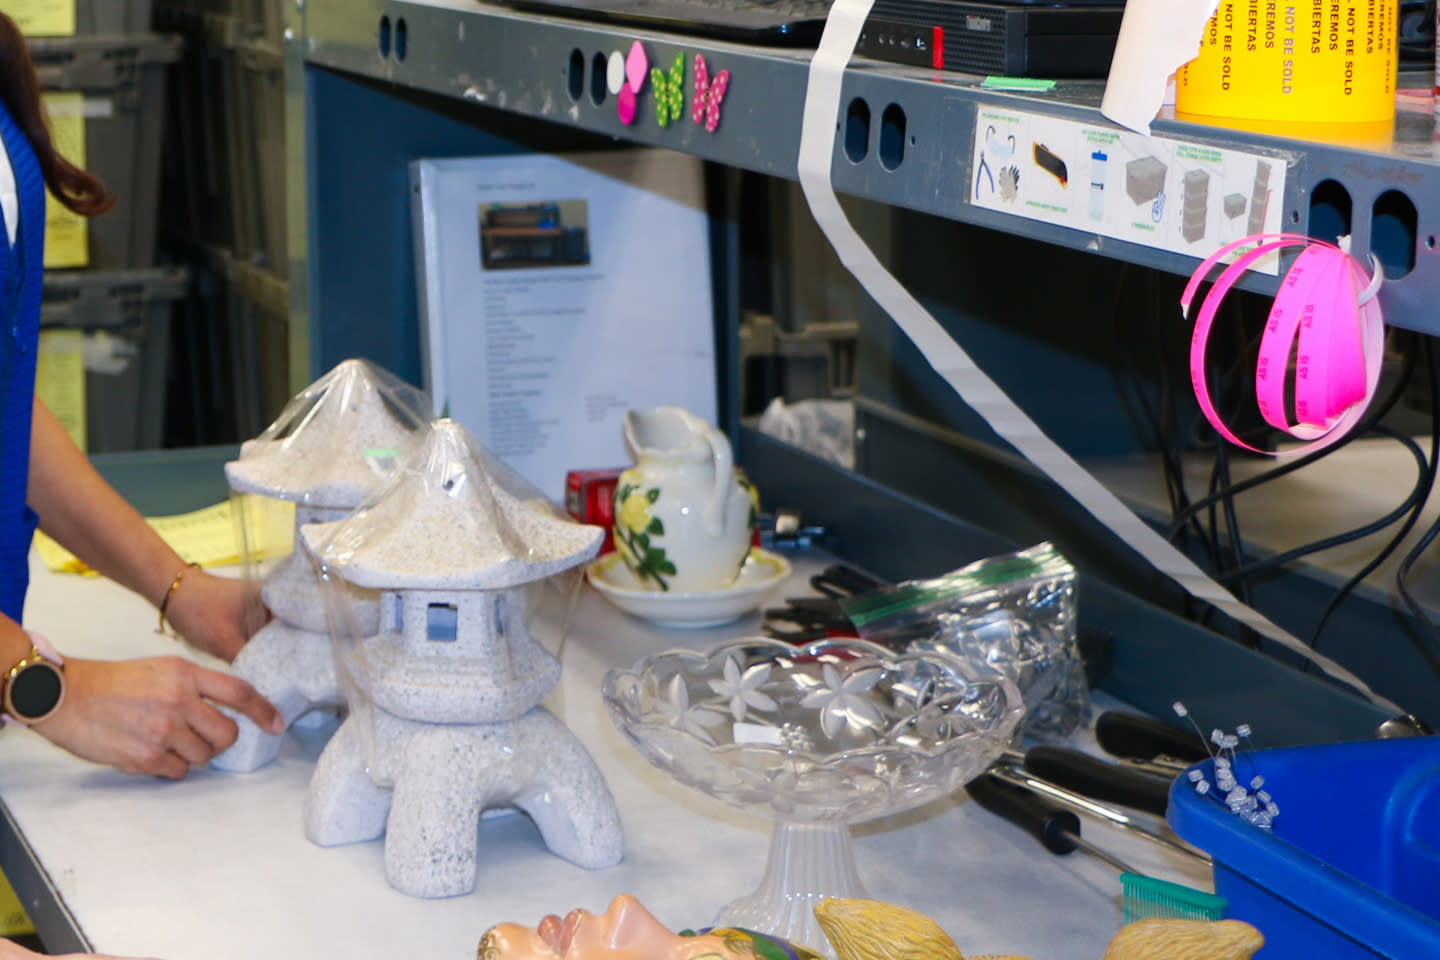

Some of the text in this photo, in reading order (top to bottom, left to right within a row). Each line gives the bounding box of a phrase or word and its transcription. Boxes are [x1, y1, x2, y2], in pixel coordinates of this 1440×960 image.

[1285, 7, 1294, 32] NOT
[1346, 8, 1355, 34] NOT
[1224, 35, 1231, 52] BE
[1284, 38, 1293, 55] BE
[1345, 40, 1353, 56] BE
[1222, 57, 1230, 90] SOLD
[1282, 60, 1292, 94] SOLD
[1344, 61, 1353, 95] SOLD
[1268, 308, 1282, 333] AS IS
[1303, 304, 1314, 328] AS IS
[1259, 357, 1268, 380] AS IS
[1300, 355, 1309, 379] AS IS
